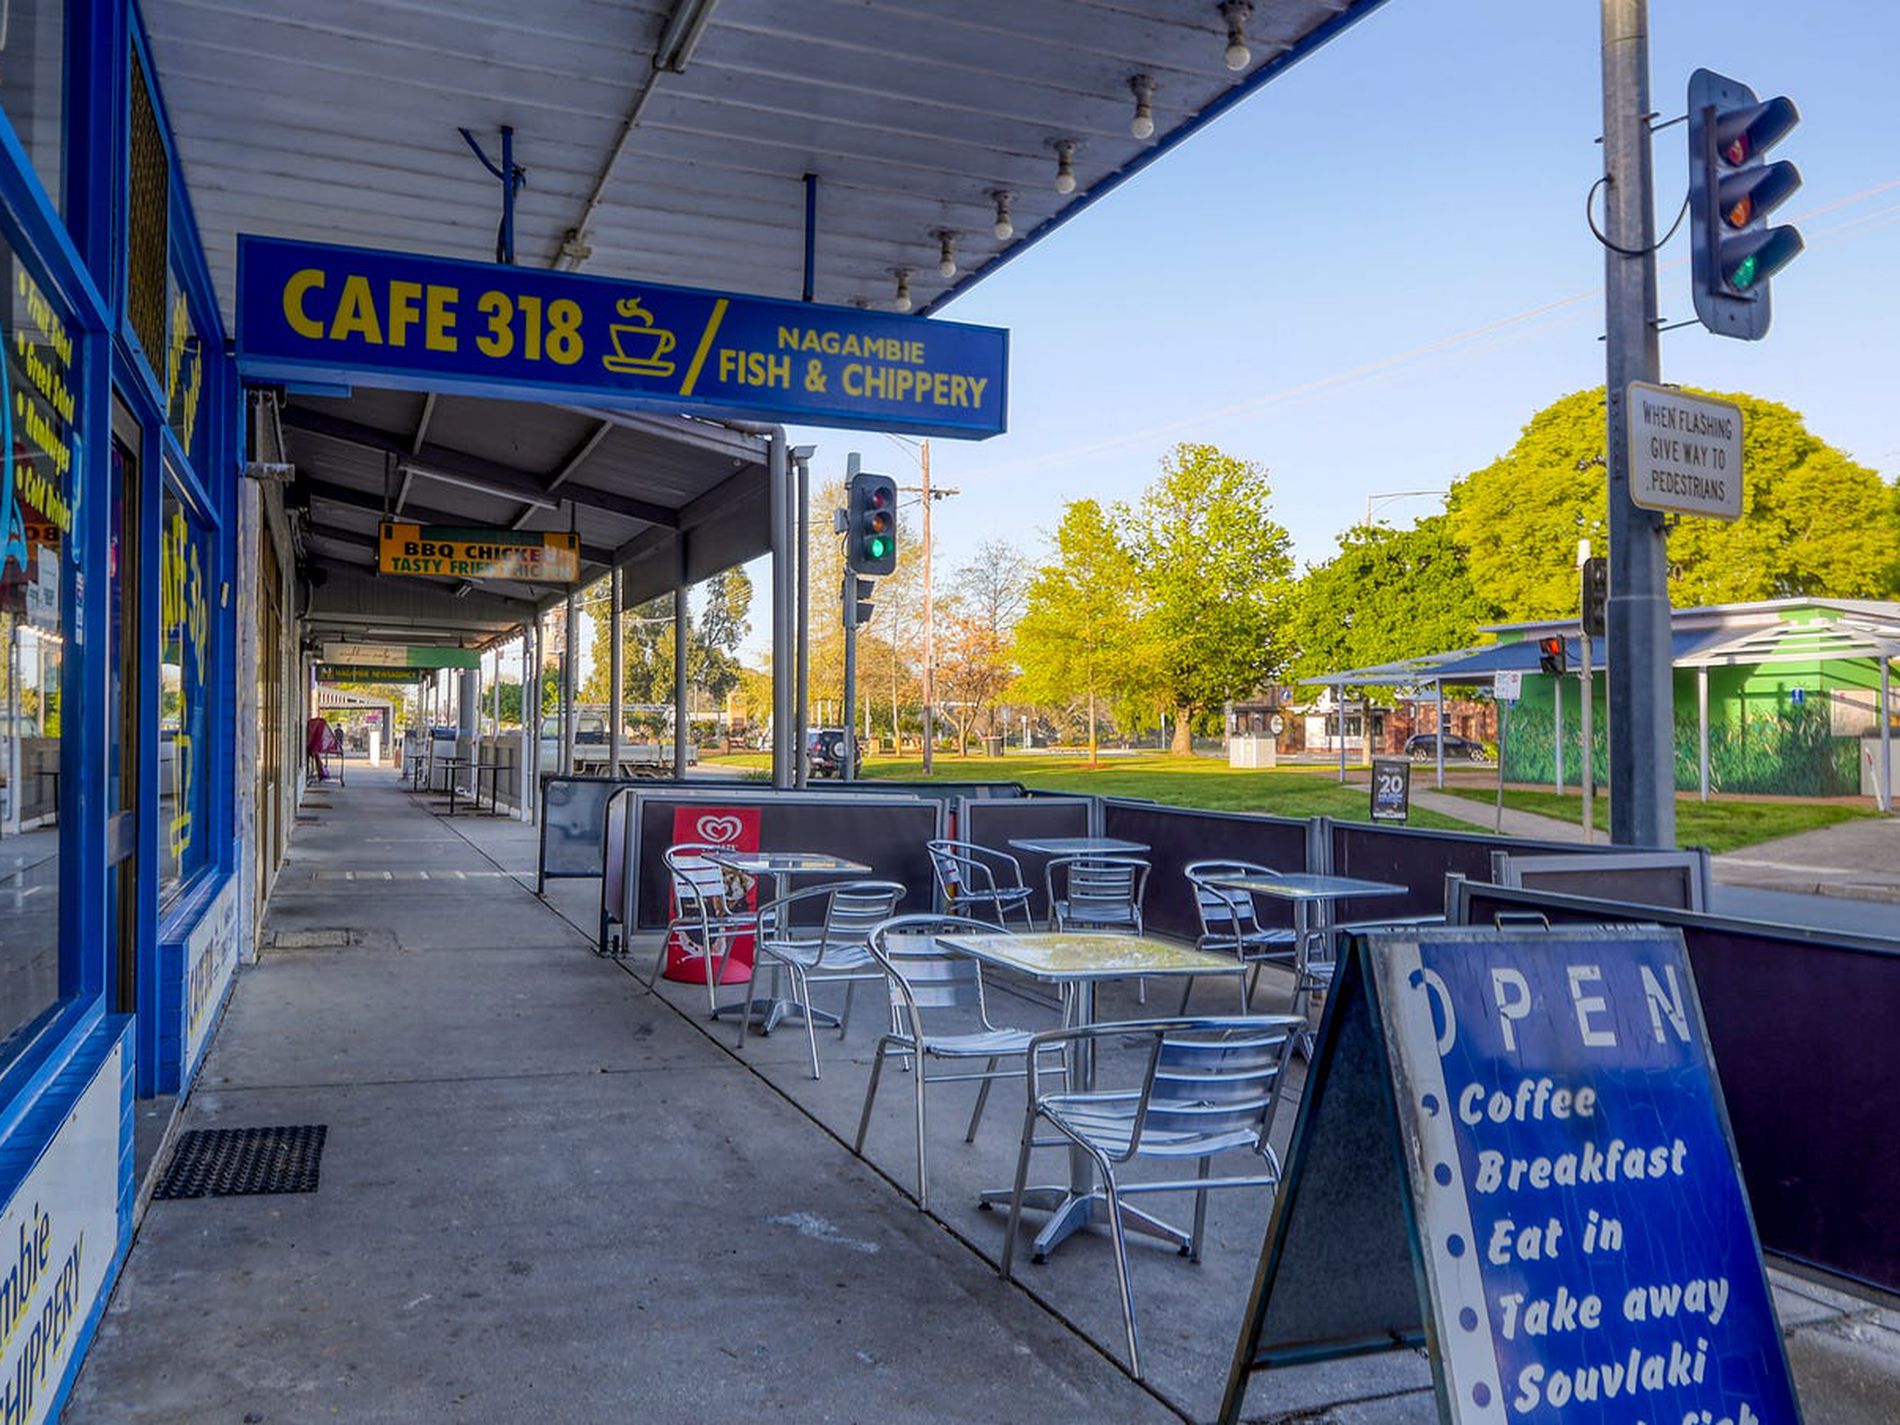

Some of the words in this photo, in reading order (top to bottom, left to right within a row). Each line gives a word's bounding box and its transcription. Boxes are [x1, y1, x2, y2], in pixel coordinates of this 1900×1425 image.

[283, 269, 459, 352] CAFE
[476, 290, 584, 366] 318
[777, 325, 925, 365] NAGAMBIE
[719, 349, 791, 388] FISH
[804, 359, 828, 393] &
[842, 363, 988, 408] CHIPPERY
[1643, 401, 1677, 430] WHEN
[1679, 410, 1732, 440] FLASHING
[1650, 437, 1679, 462] GIVE
[1682, 443, 1708, 467] WAY
[1712, 448, 1726, 470] TO
[1652, 470, 1726, 501] PEDESTRIANS
[392, 557, 442, 572] TASTY
[404, 542, 454, 559] BBQ
[465, 545, 556, 563] CHICKE
[1409, 965, 1692, 1057] OPEN
[1459, 1078, 1596, 1125] Coffee
[1475, 1139, 1687, 1194] Breakfast
[1488, 1218, 1563, 1265] Eat
[1583, 1209, 1623, 1253] in
[0, 1231, 83, 1425] HIPPERY
[1498, 1286, 1602, 1340] Take
[1623, 1278, 1729, 1325] away
[1513, 1337, 1708, 1414] Souvlaki
